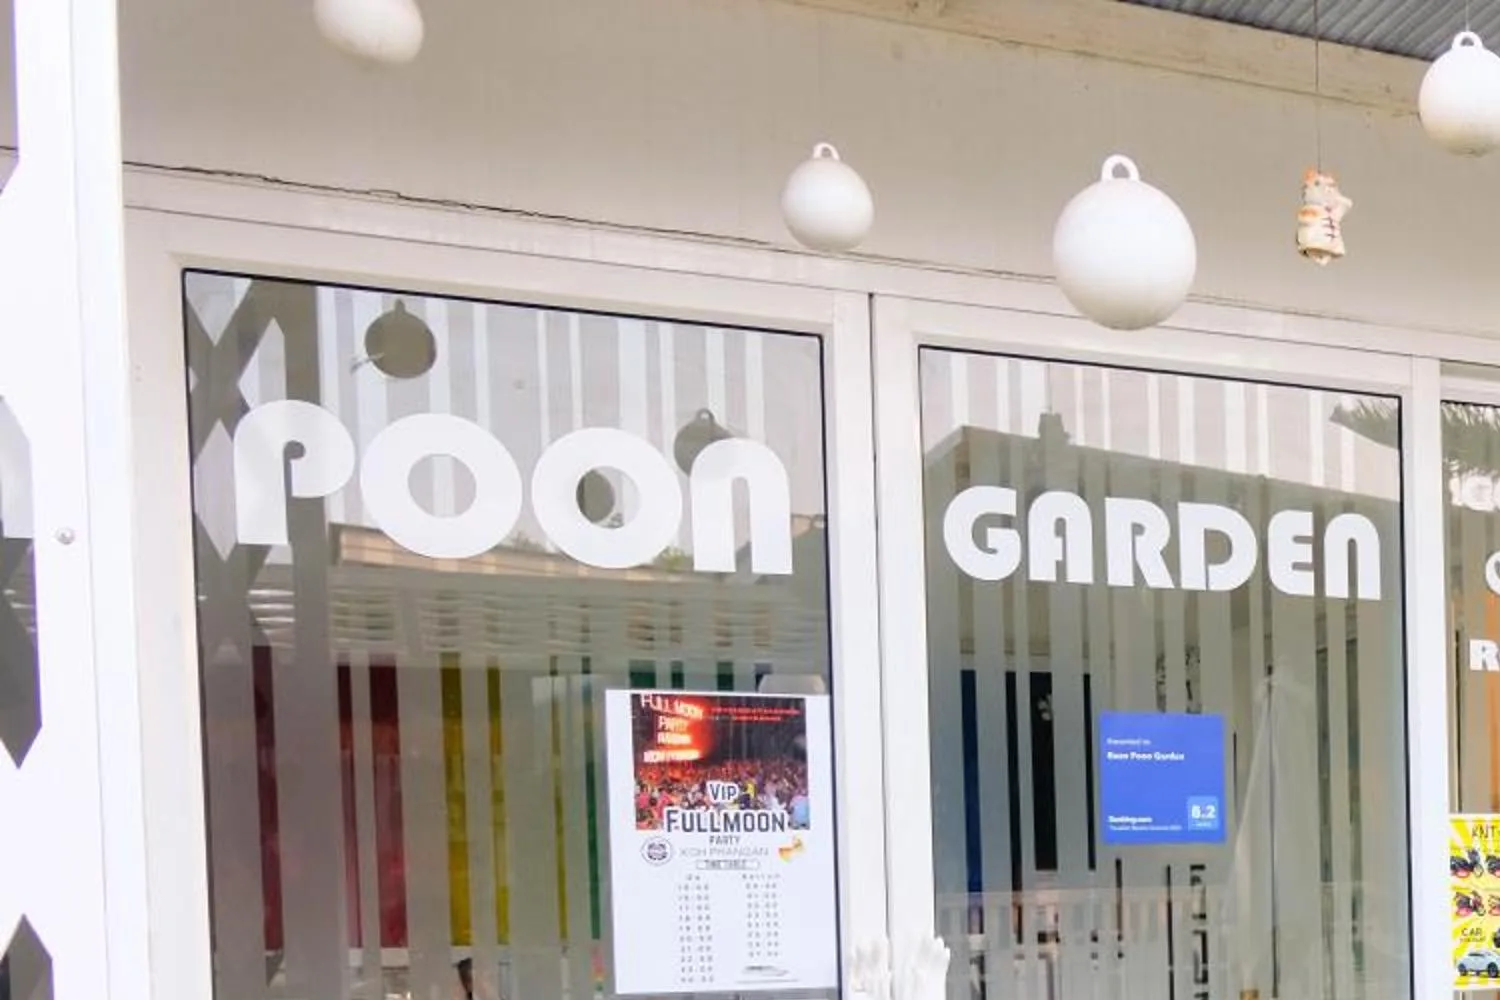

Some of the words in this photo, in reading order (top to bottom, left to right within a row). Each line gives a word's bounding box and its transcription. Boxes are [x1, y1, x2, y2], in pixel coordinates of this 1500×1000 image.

[233, 399, 793, 575] POON
[943, 485, 1381, 600] GARDEN
[709, 783, 738, 801] VIP
[666, 809, 787, 833] FULLMOON
